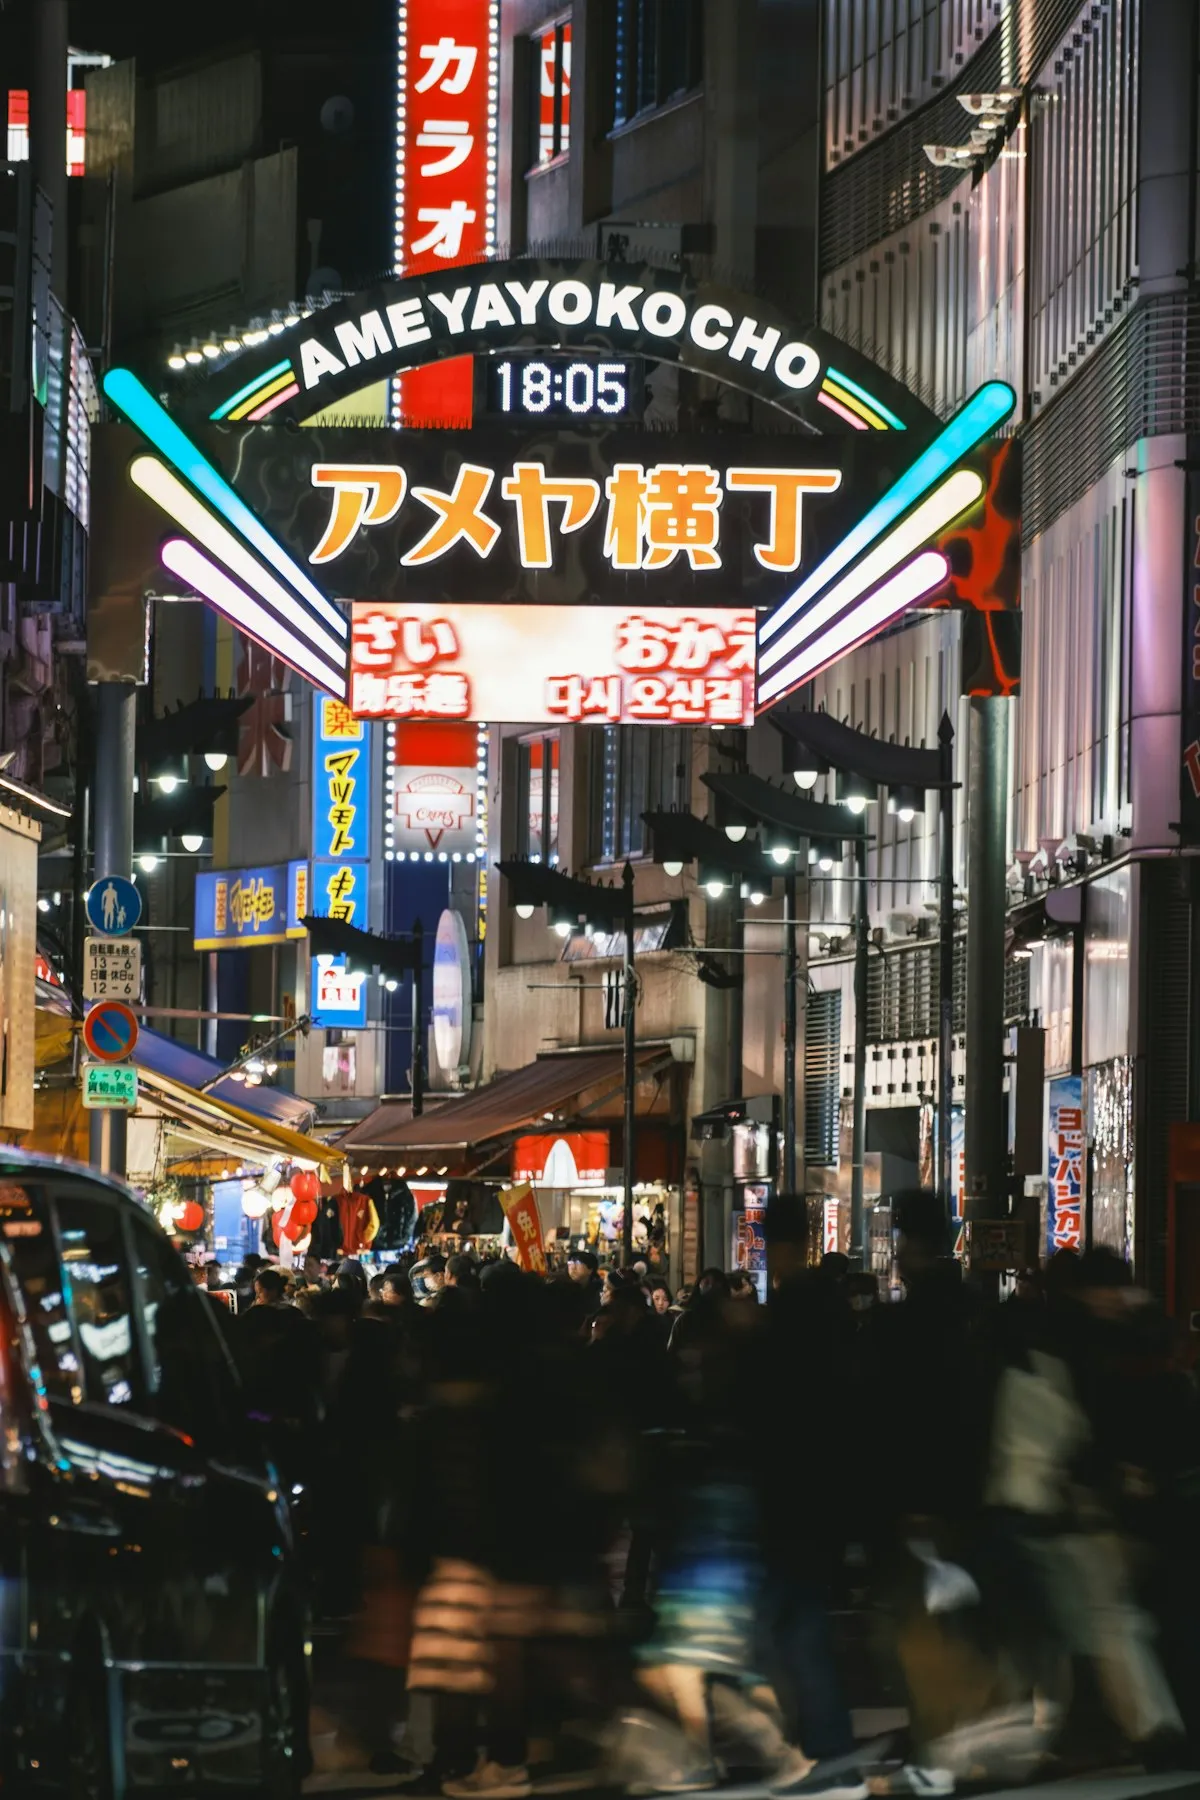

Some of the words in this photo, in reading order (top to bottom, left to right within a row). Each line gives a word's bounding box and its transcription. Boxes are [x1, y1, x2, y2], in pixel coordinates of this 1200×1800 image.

[411, 37, 478, 258] カラオ
[298, 280, 821, 390] AMEYAYOKOCHO
[498, 362, 626, 414] 18:05
[309, 462, 842, 572] アメヤ横丁
[547, 674, 622, 722] 다시
